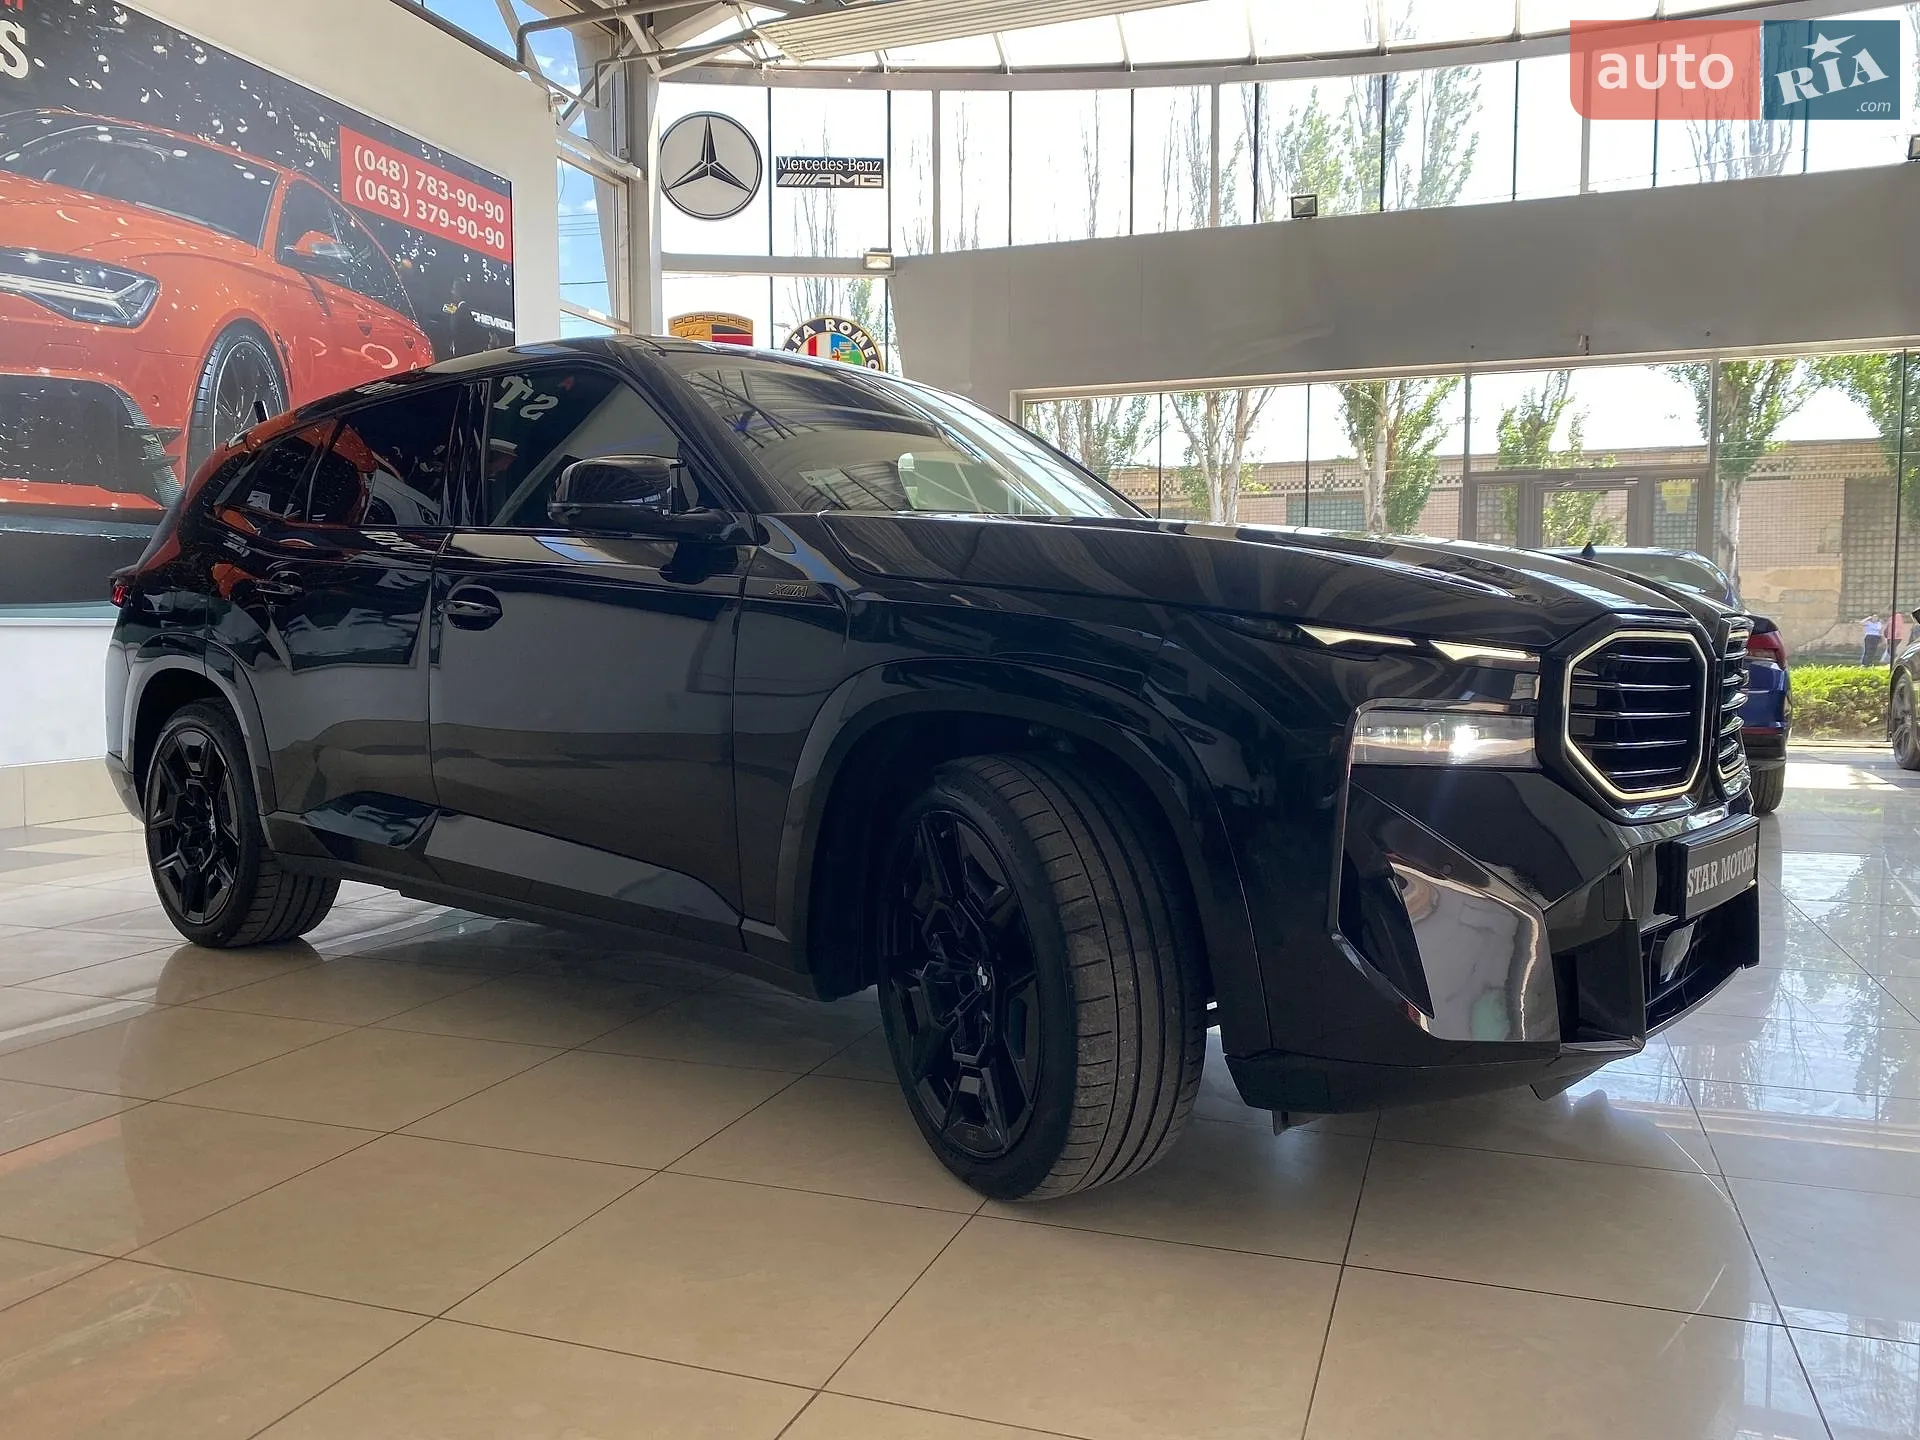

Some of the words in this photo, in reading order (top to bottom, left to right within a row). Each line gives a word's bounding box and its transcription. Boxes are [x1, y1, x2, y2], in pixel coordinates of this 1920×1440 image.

[354, 145, 409, 189] (048)
[415, 170, 505, 224] 783-90-90
[777, 156, 881, 172] Mercedes-Benz
[355, 175, 411, 218] (063)
[416, 199, 505, 250] 379-90-90
[673, 314, 750, 328] PORSCHE
[783, 324, 816, 353] LFA
[824, 318, 880, 369] ROMEO
[1687, 861, 1718, 898] STAR
[1720, 843, 1757, 884] MOTORS
